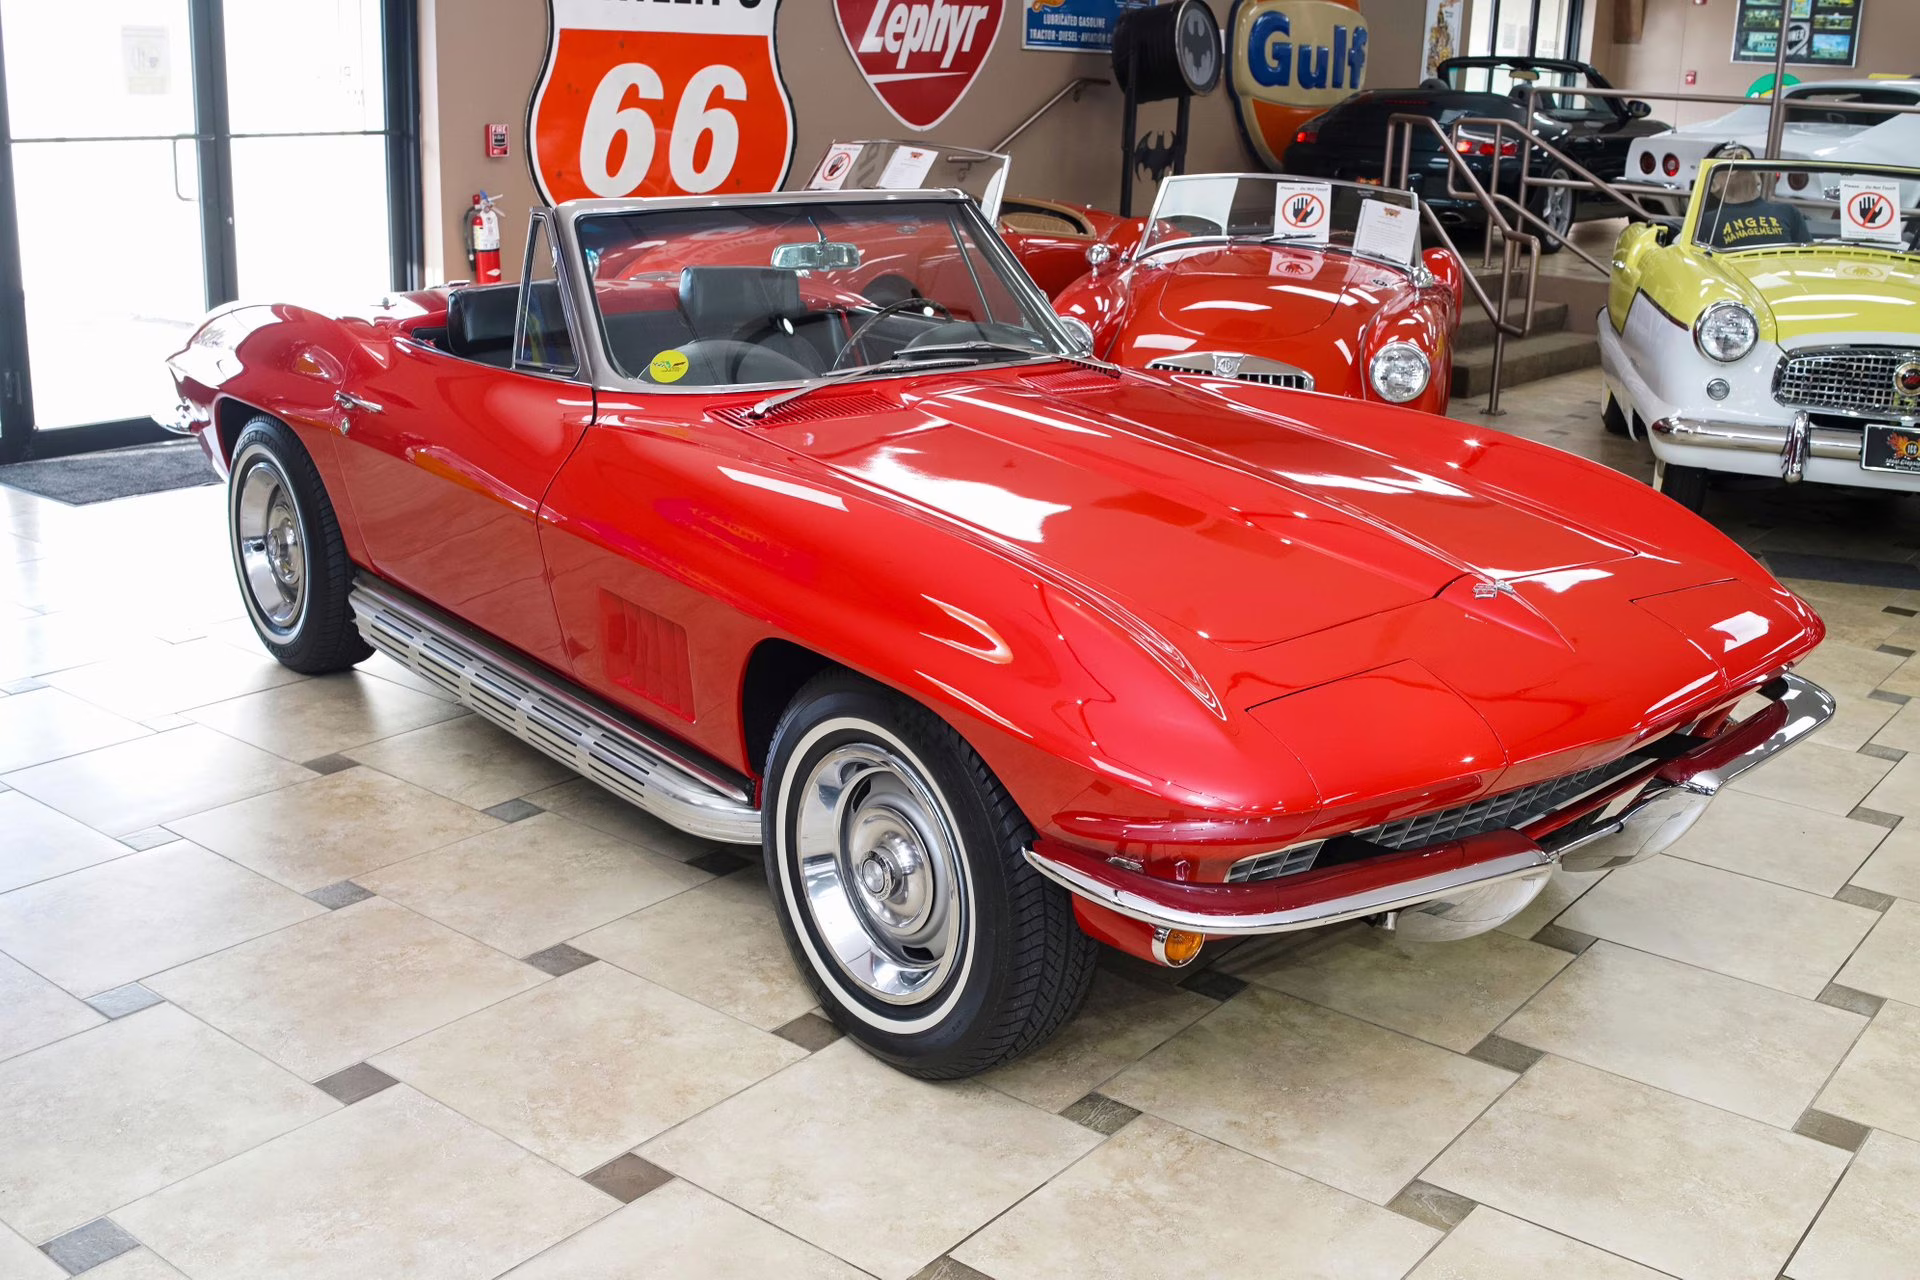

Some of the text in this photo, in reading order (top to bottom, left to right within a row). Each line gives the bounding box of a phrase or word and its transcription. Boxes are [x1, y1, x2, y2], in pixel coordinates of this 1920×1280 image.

[858, 0, 990, 69] Zephyr
[1043, 13, 1106, 28] LUBRICATED GASOLINE
[1247, 10, 1368, 90] Gulf
[580, 62, 747, 198] 66
[1723, 215, 1780, 235] ANGER
[1723, 227, 1783, 245] MANAGEMENT
